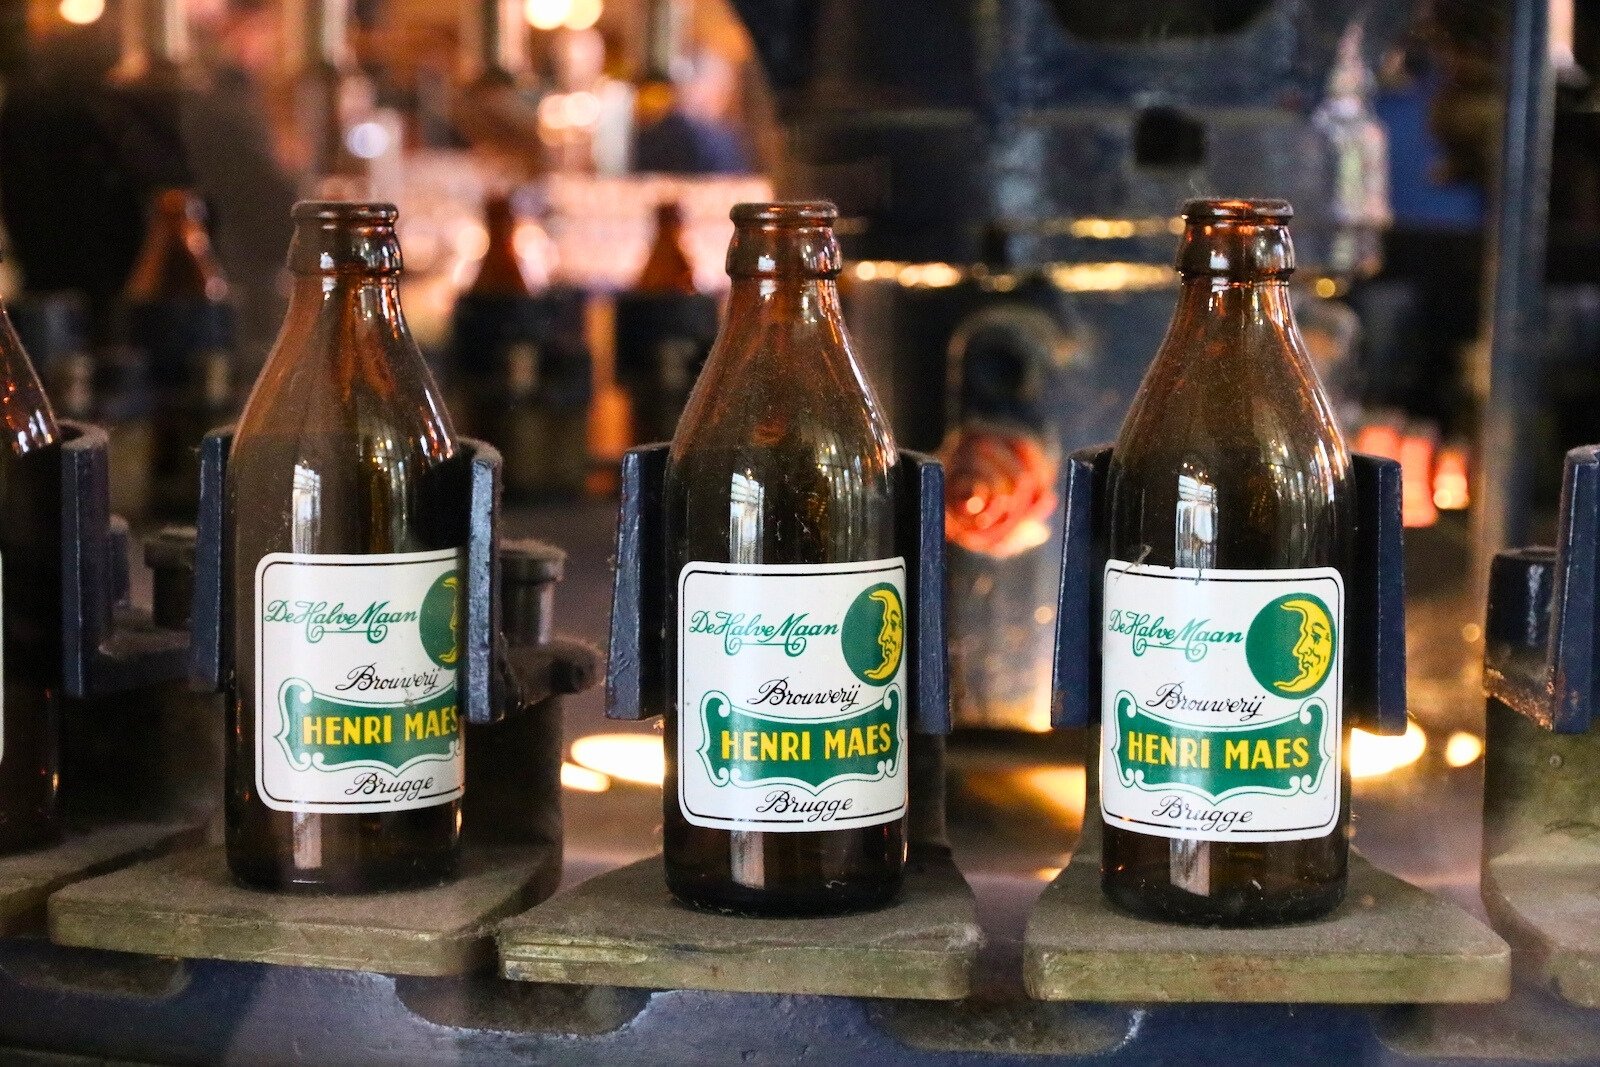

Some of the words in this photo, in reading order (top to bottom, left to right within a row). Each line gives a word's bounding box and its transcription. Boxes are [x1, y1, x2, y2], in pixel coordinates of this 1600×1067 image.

[264, 600, 293, 622] De
[293, 601, 357, 643] Halve
[340, 601, 418, 643] Maan
[688, 610, 713, 634] De
[713, 611, 777, 656] Halve
[757, 613, 839, 657] Maan
[1107, 609, 1125, 633] De
[1122, 610, 1175, 657] Halve
[1159, 617, 1243, 662] Maan
[335, 662, 444, 695] Brouwerij
[747, 676, 861, 711] Brouwerij
[1145, 680, 1265, 721] Brouwerij
[302, 715, 392, 745] HENRI
[721, 730, 810, 760] HENRI
[824, 723, 891, 760] MAES
[1128, 730, 1210, 769] HENRI
[1225, 737, 1310, 770] MAES
[345, 772, 433, 802] Brugge
[755, 790, 853, 822] Brugge
[1151, 795, 1253, 833] Brugge
